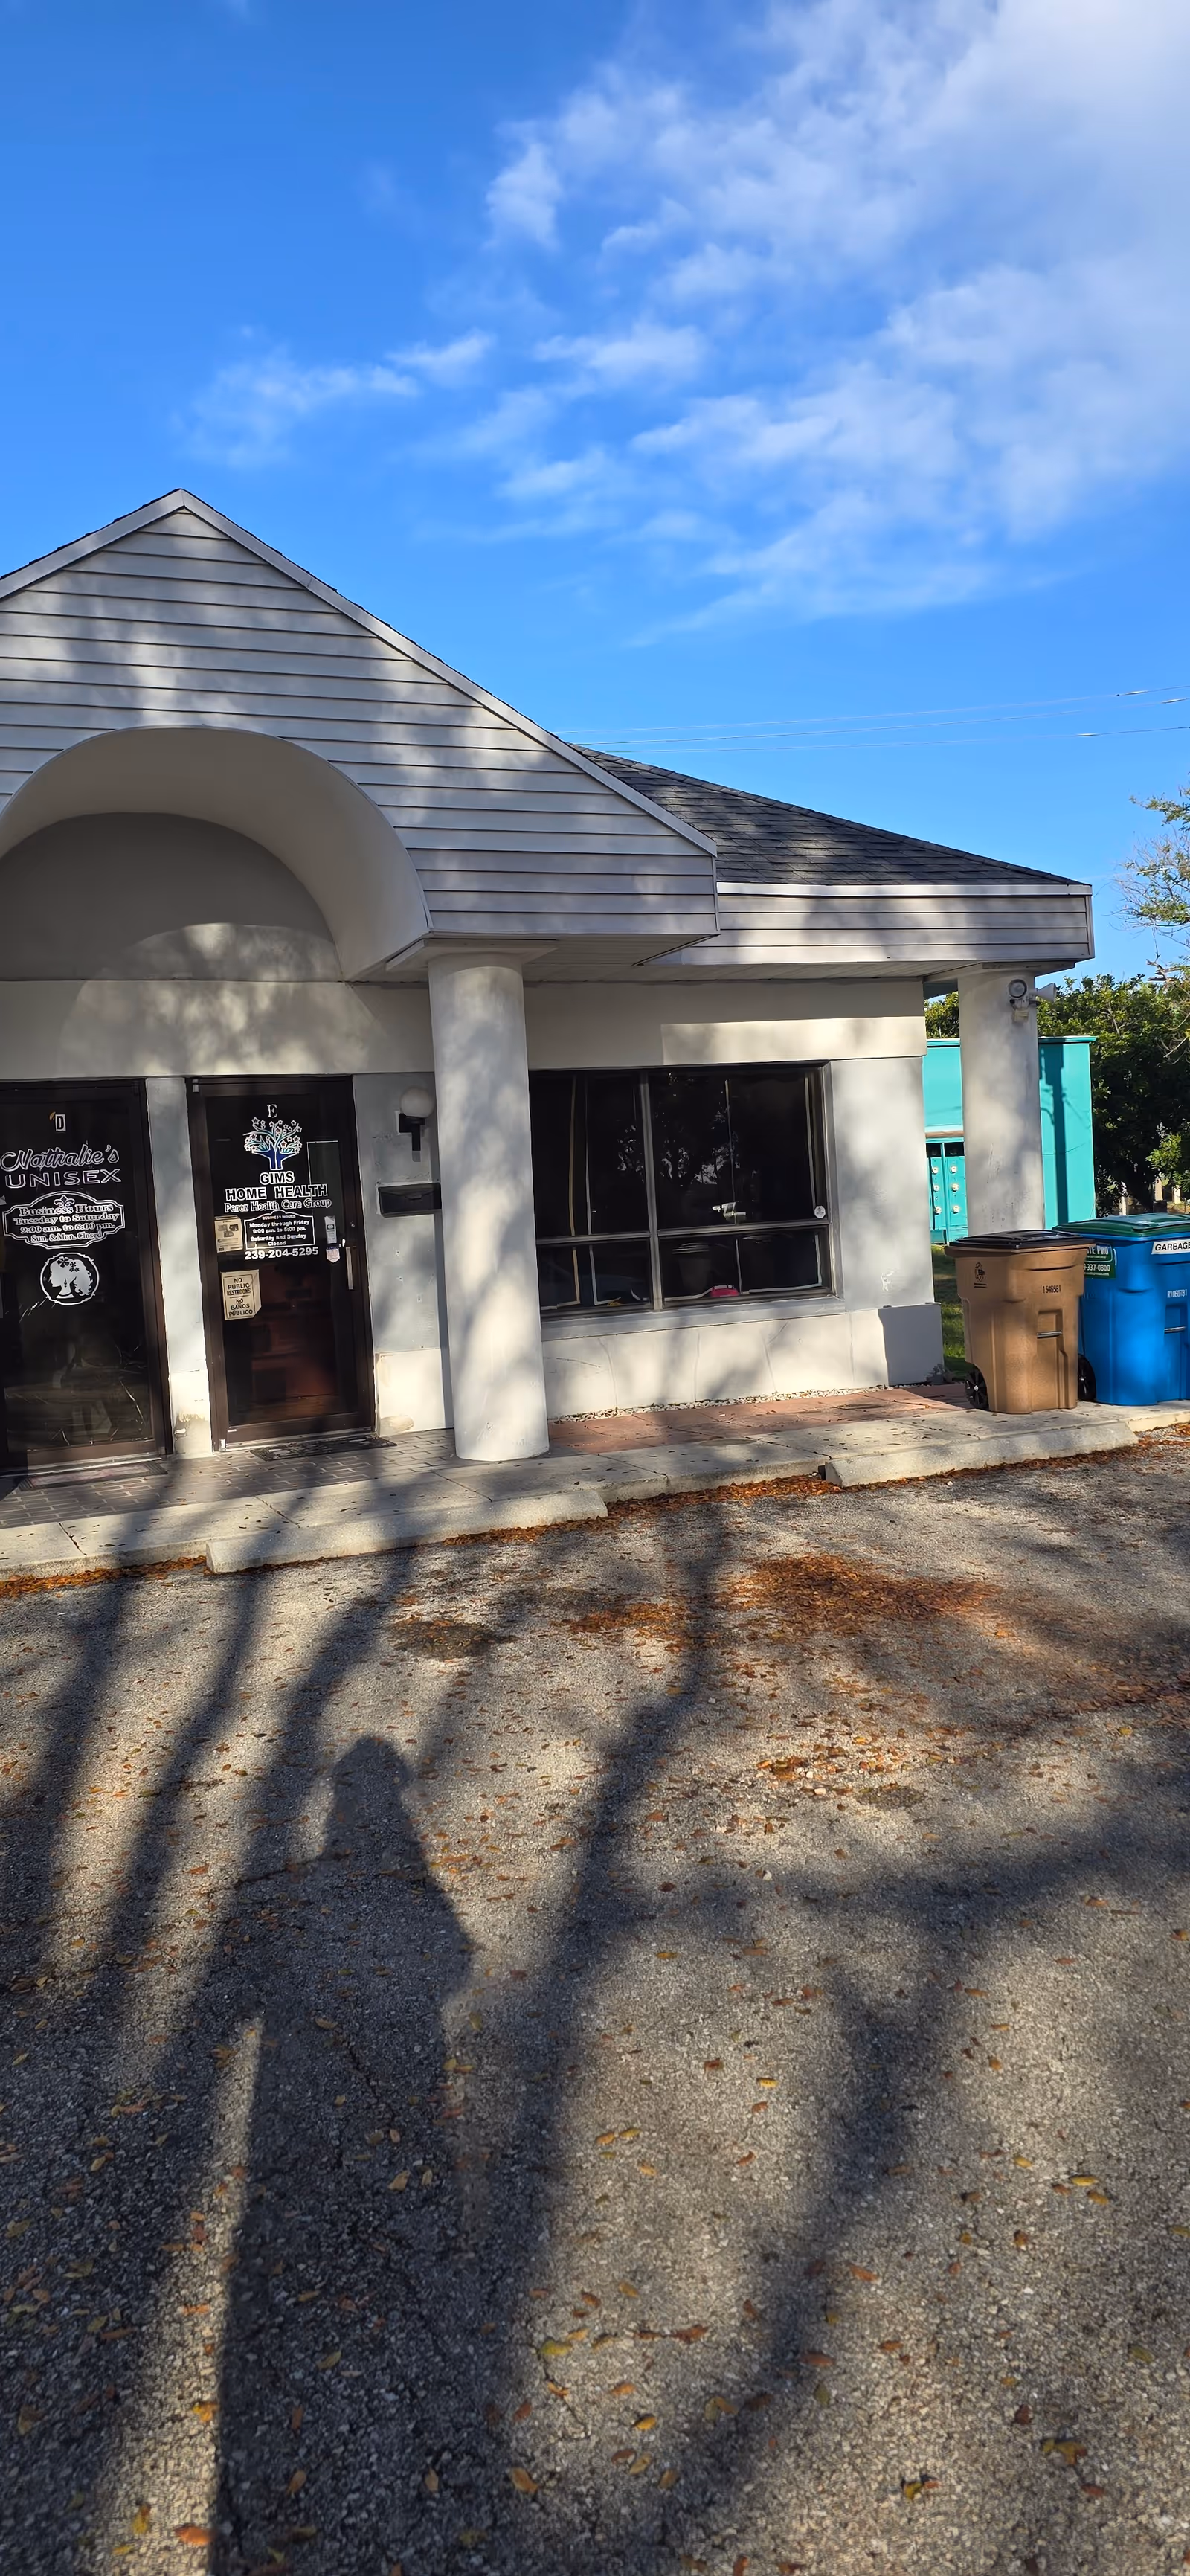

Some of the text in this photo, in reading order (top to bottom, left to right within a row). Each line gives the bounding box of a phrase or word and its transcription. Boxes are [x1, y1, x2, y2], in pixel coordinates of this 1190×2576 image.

[56, 1115, 65, 1130] D
[0, 1144, 120, 1172] Nathalie's
[5, 1169, 121, 1189] UNISEX
[260, 1171, 295, 1185] GIMS
[225, 1183, 328, 1201] HOME HEALTH
[19, 1204, 114, 1217] Business Hours
[224, 1198, 332, 1213] Perez Health Care Group
[13, 1215, 58, 1225] Tuesday
[72, 1212, 120, 1222] Saturday
[20, 1226, 42, 1234] 9:00
[74, 1222, 95, 1231] 6:00
[96, 1222, 115, 1231] pm.
[30, 1234, 48, 1242] Sun.
[77, 1230, 103, 1240] Closed
[244, 1247, 319, 1260] 239-204-5295
[227, 1288, 251, 1296] RESTROOMS
